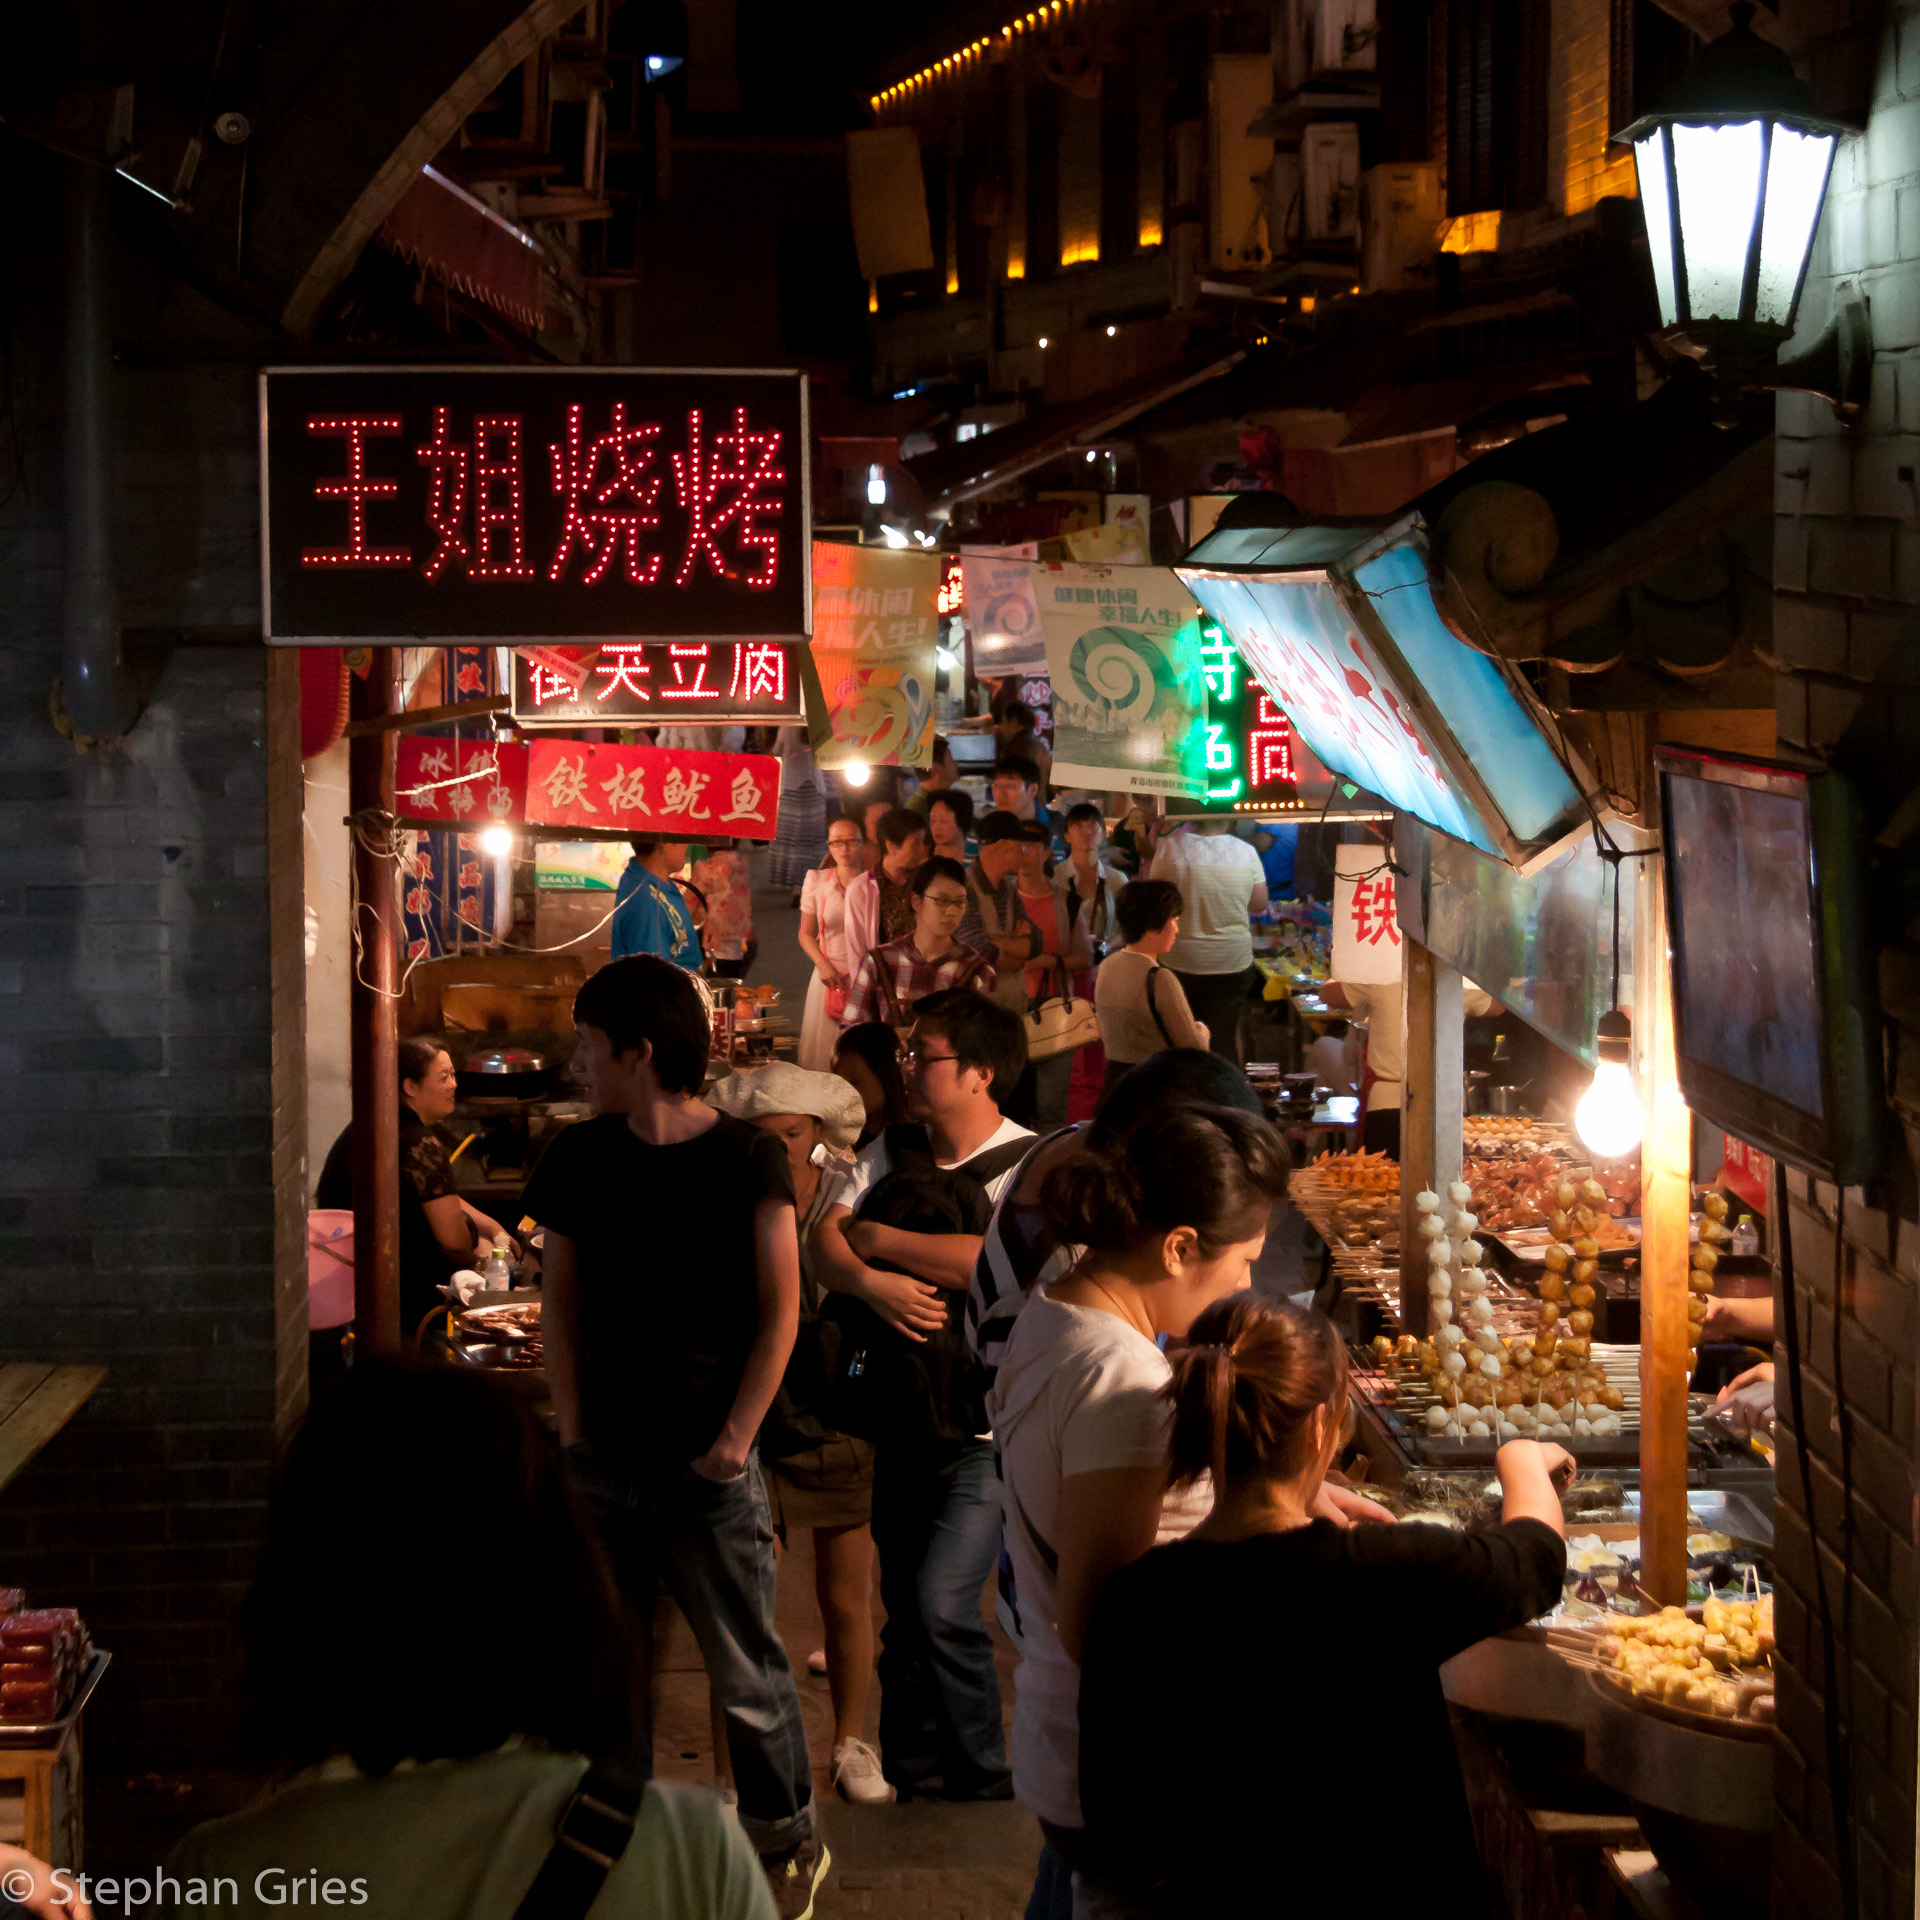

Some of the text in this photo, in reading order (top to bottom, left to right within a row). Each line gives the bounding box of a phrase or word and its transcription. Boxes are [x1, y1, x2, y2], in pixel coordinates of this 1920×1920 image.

[302, 402, 786, 592] 王姐烧烤
[540, 754, 768, 824] 铁板鱿鱼
[1351, 876, 1402, 947] 铁
